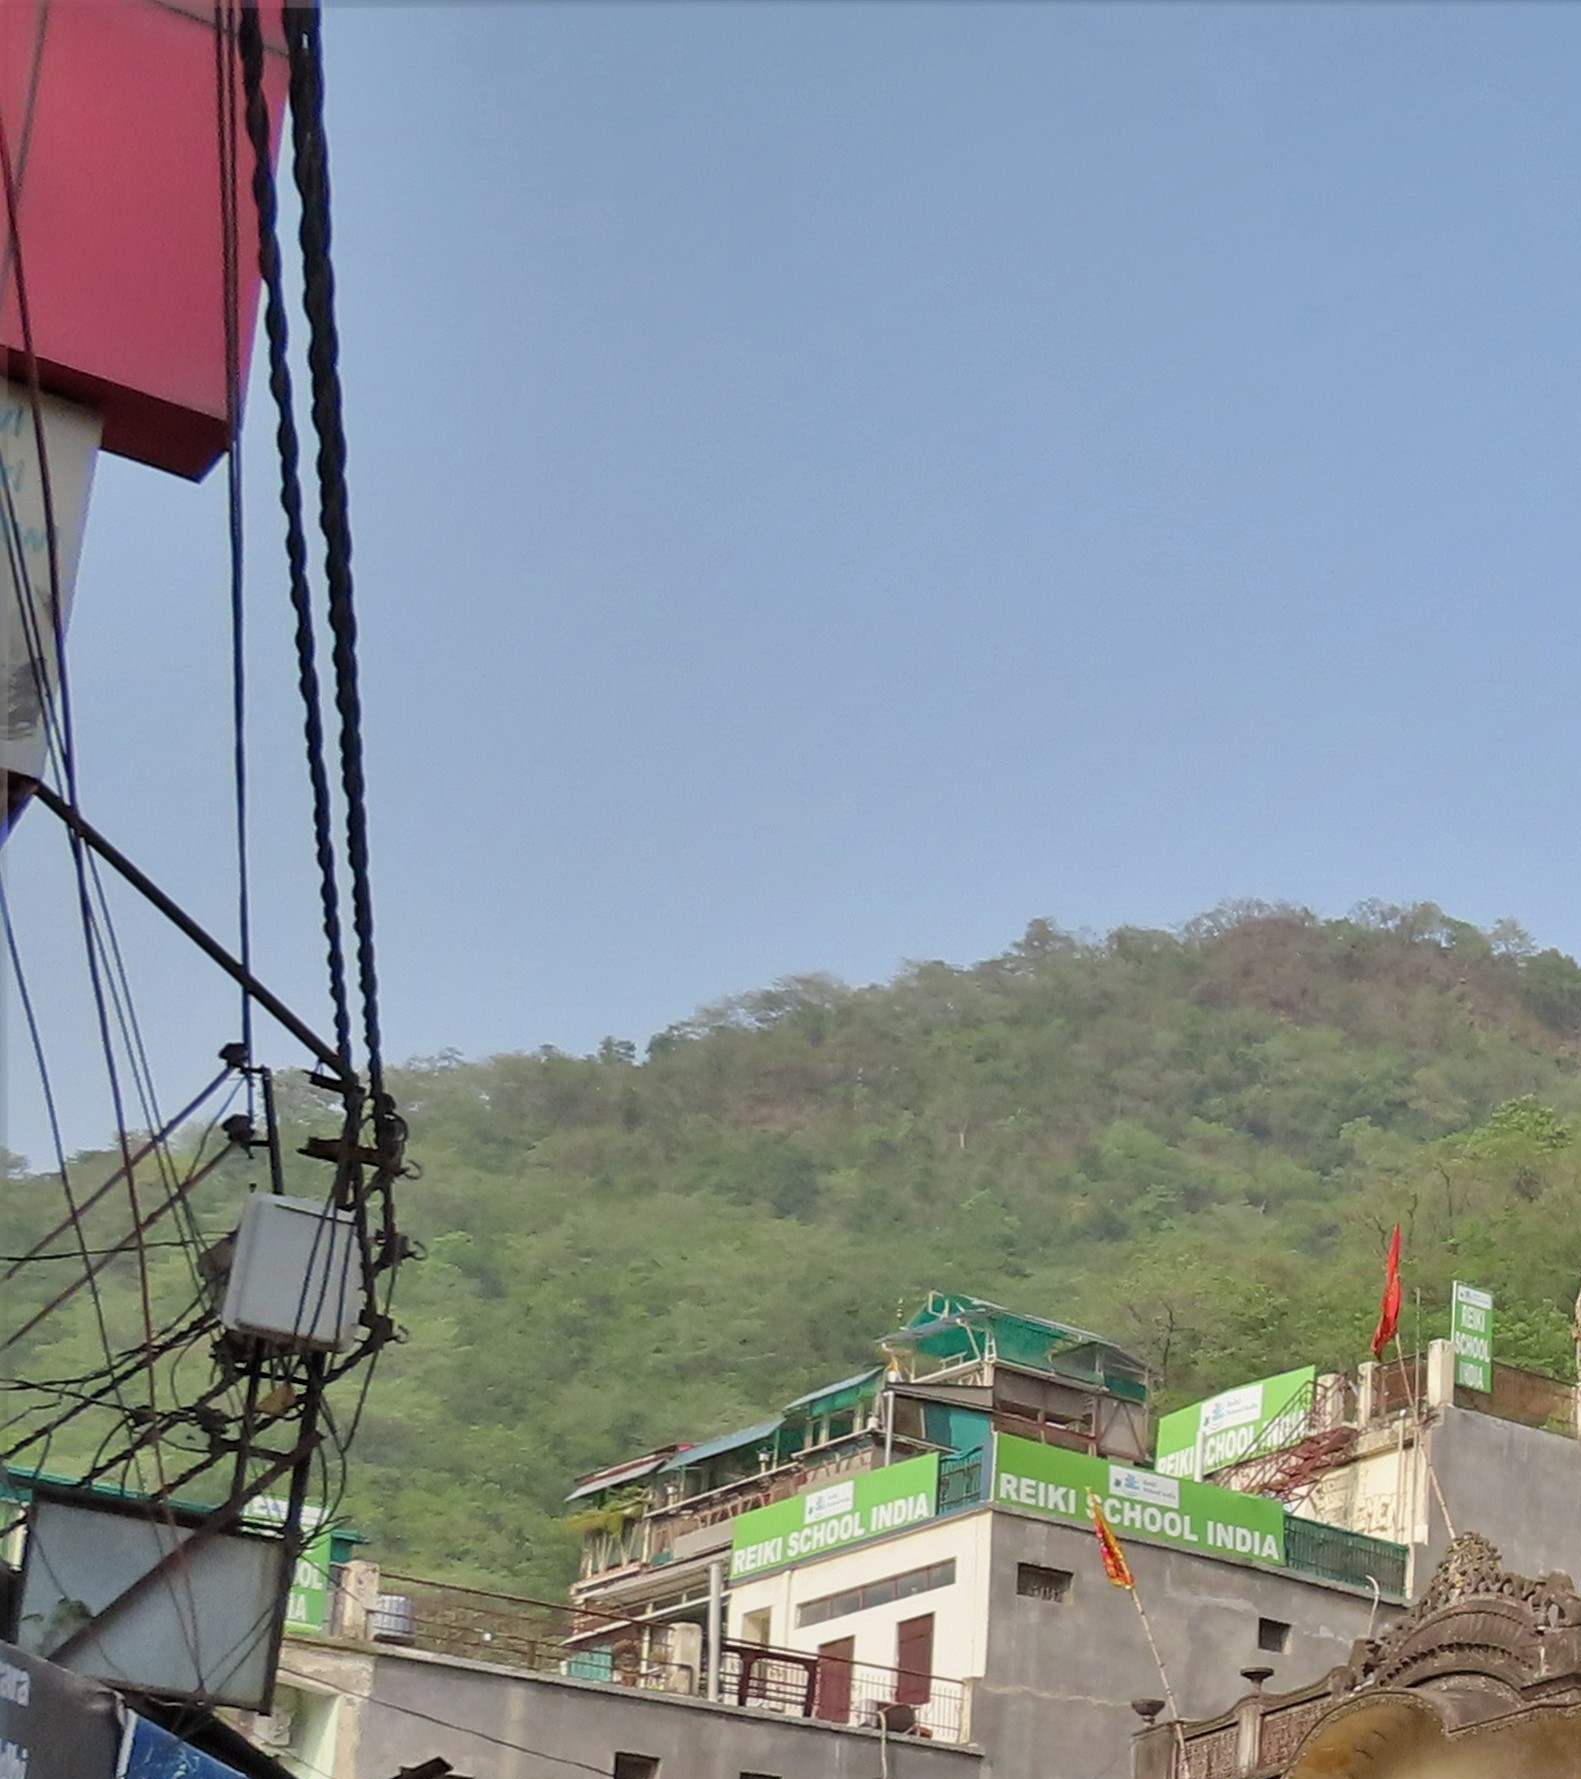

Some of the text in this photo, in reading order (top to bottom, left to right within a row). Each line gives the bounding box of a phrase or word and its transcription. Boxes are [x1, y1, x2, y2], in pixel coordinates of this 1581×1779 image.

[1456, 1331, 1490, 1362] SCHOOL
[1204, 1425, 1257, 1465] CHOOL
[733, 1492, 929, 1576] REIKI SCHOOL INDIA
[999, 1472, 1280, 1560] REIKI SCHOOL INDIA
